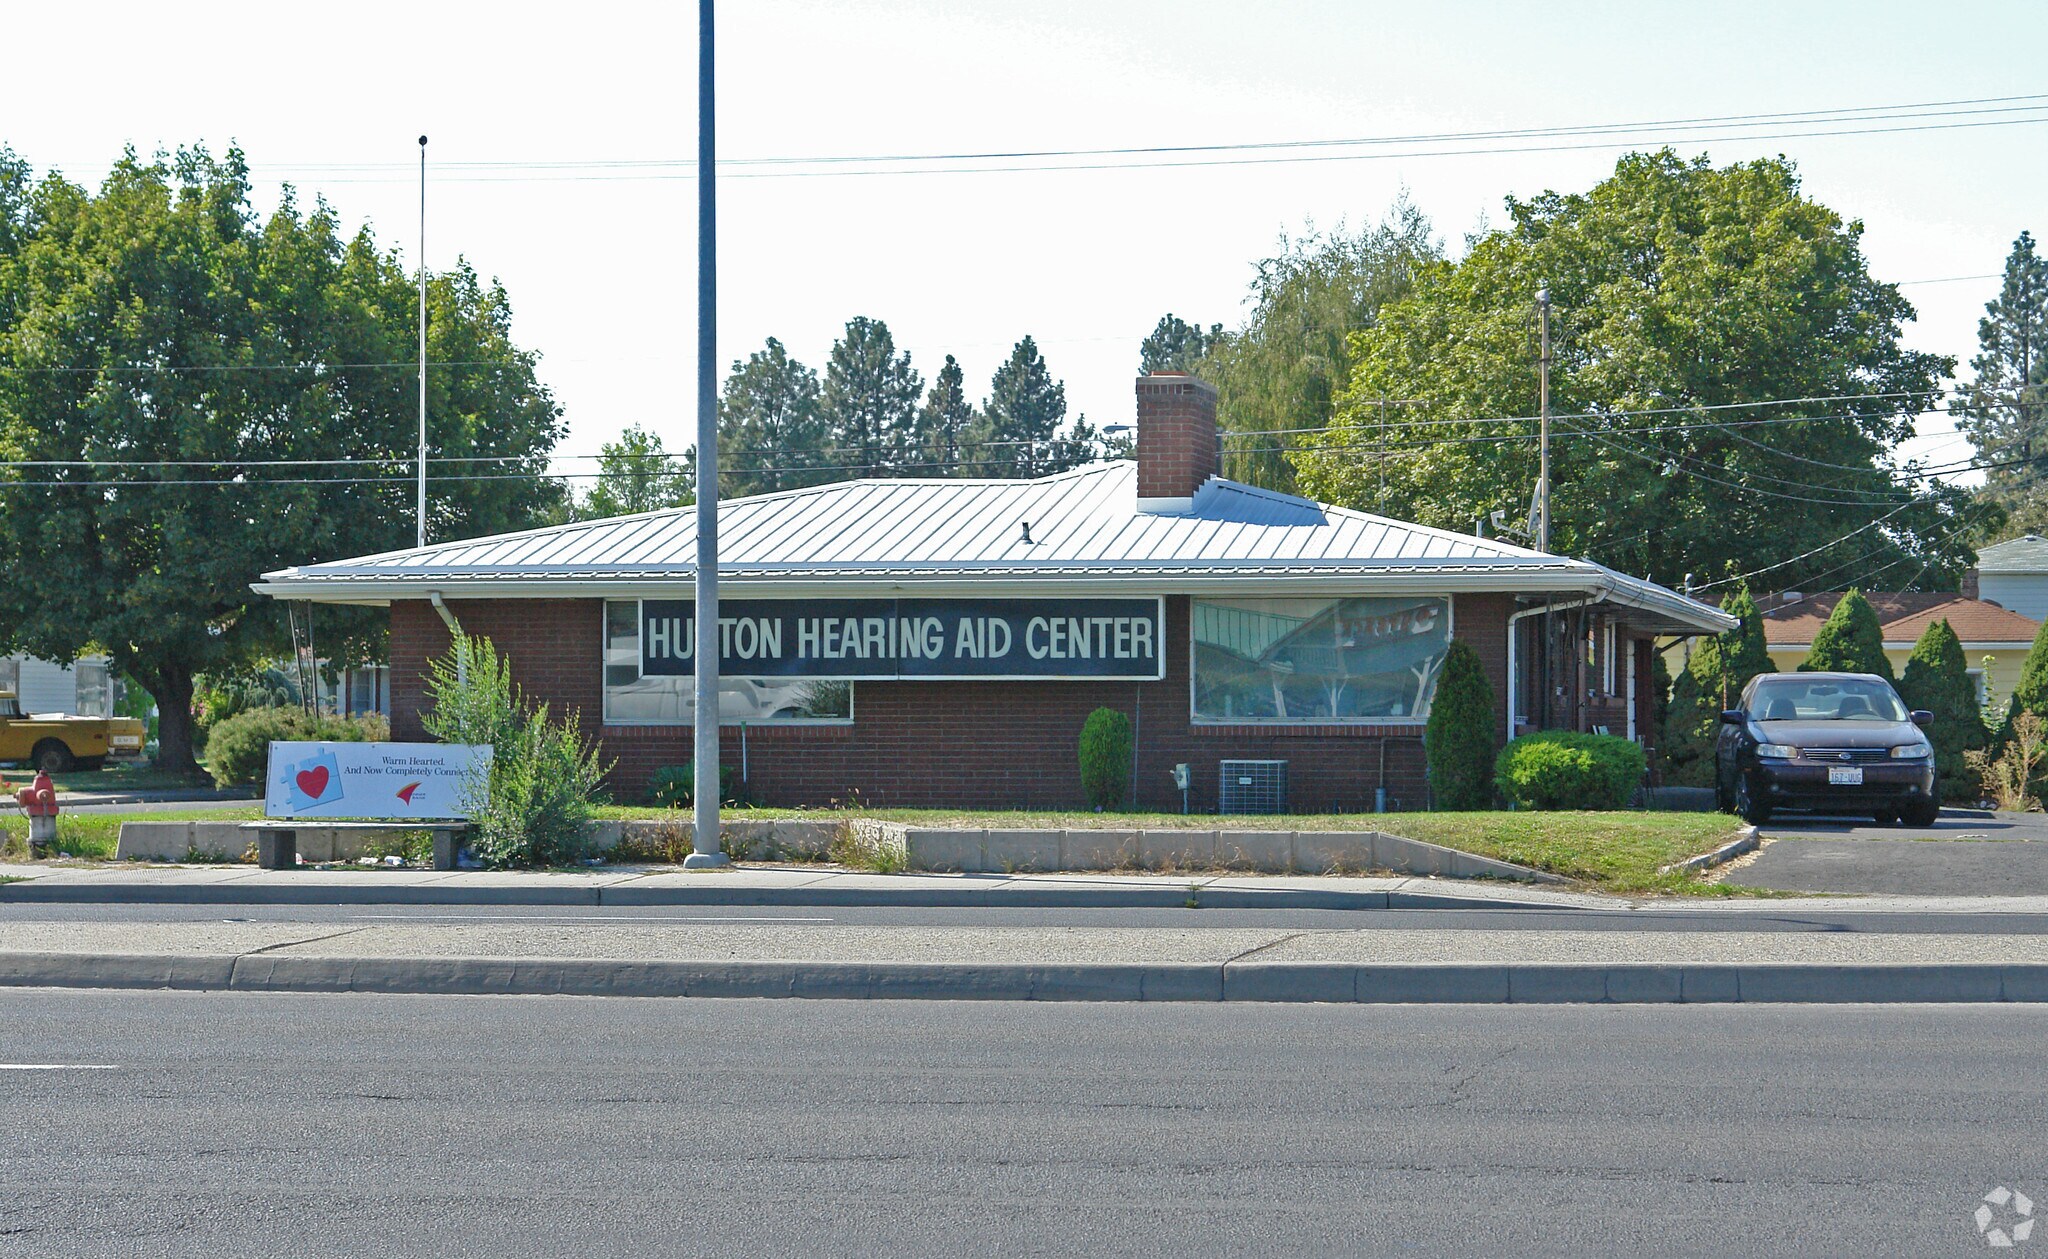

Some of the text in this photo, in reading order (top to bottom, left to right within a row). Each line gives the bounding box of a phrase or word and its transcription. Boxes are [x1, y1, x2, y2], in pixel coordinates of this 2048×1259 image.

[649, 616, 1154, 660] HUTON HEARING AID CENTER
[382, 756, 445, 766] Warm Hearted.
[344, 766, 361, 775] And
[364, 766, 383, 775] Now
[385, 766, 433, 777] Completely
